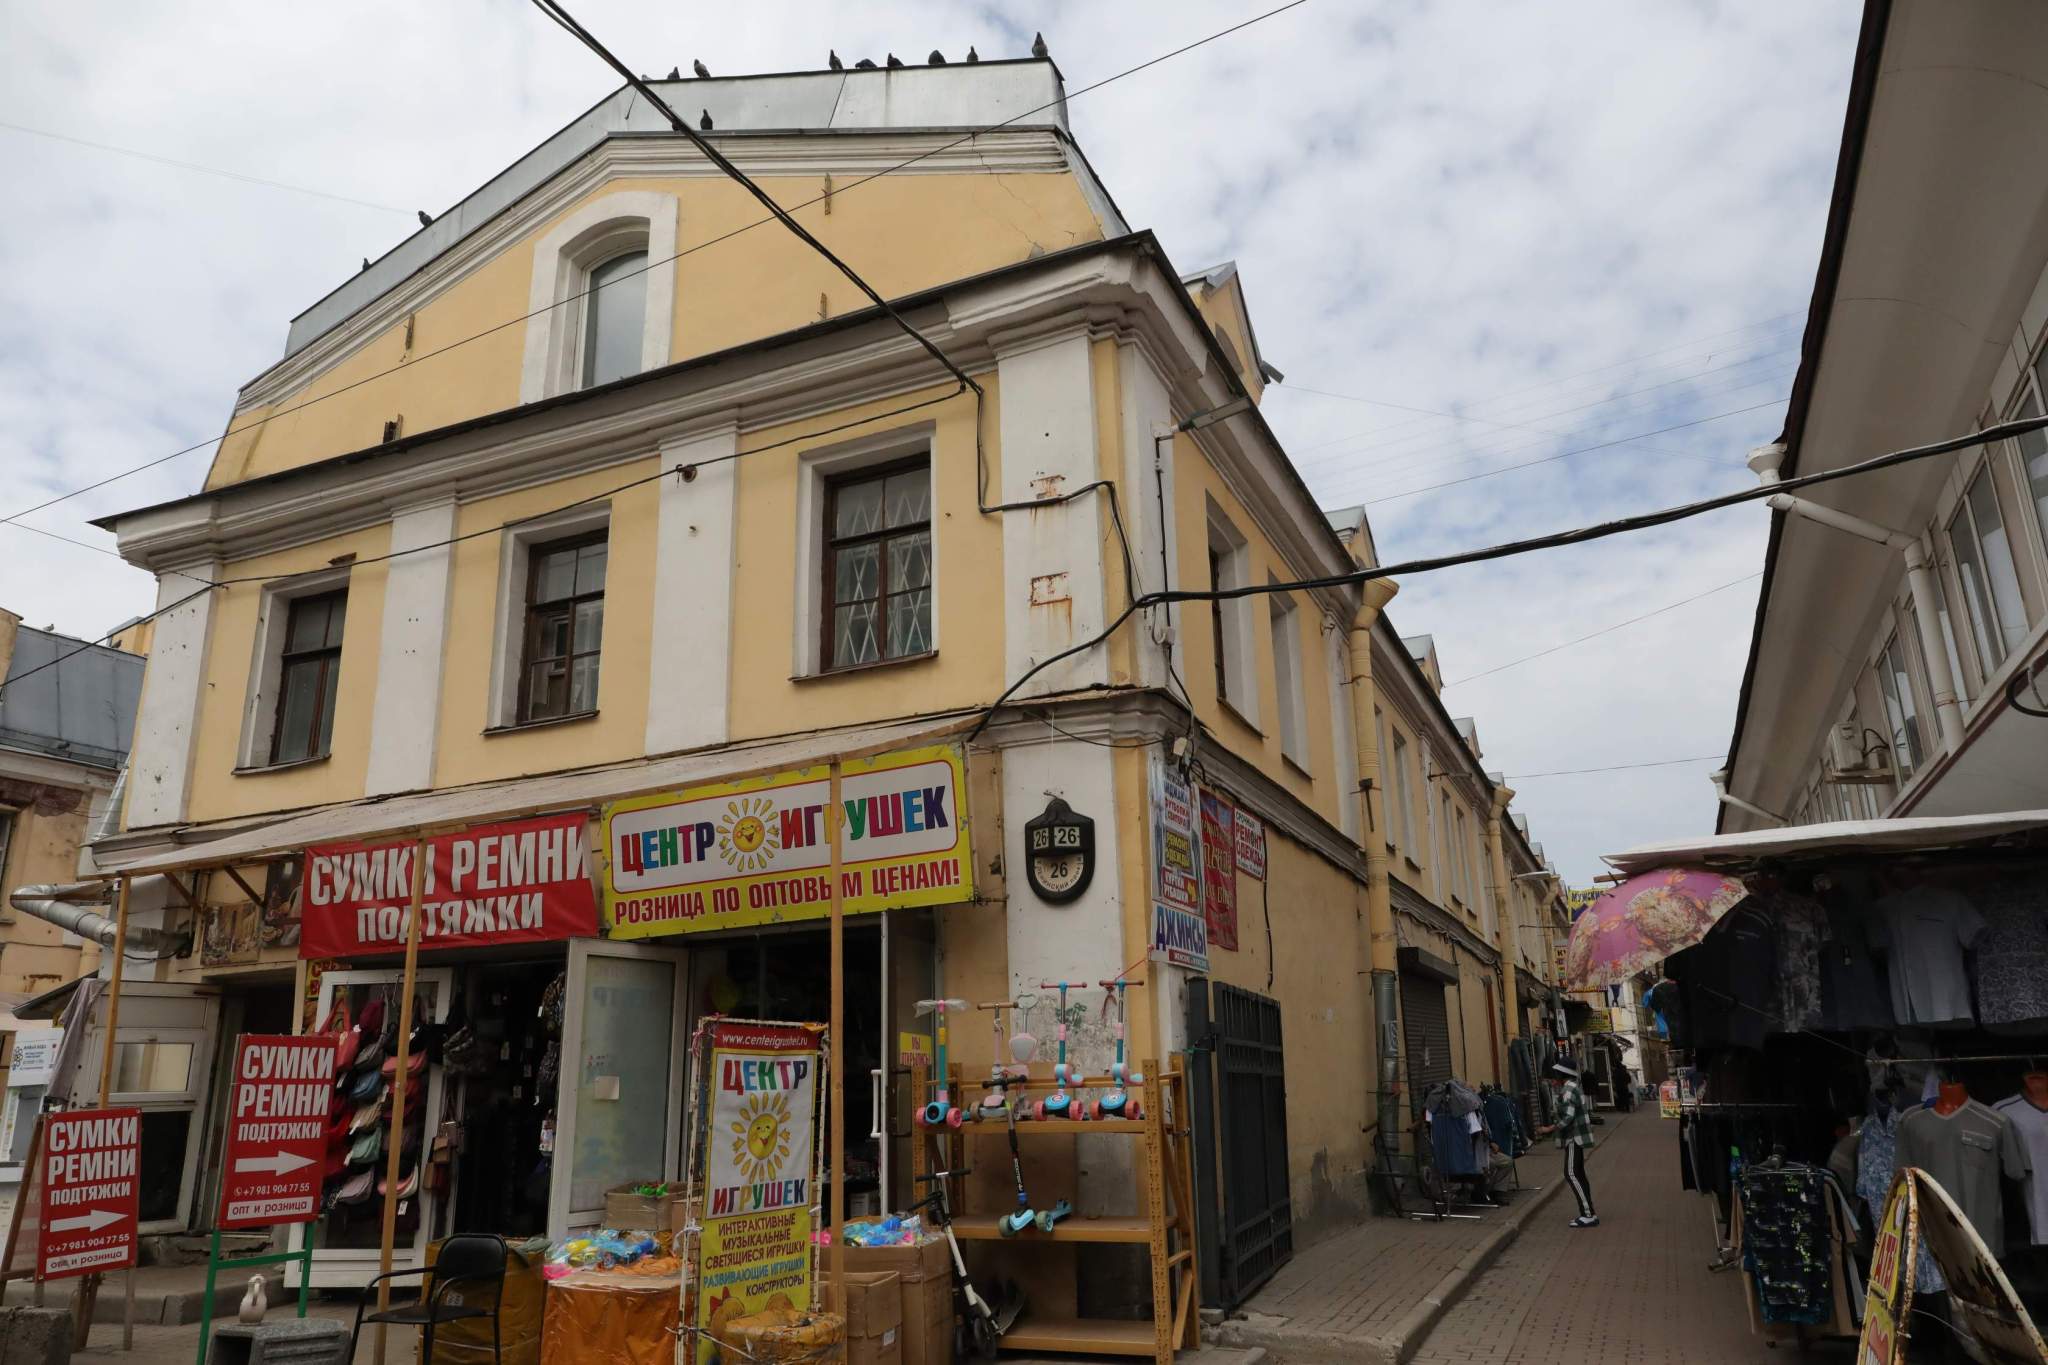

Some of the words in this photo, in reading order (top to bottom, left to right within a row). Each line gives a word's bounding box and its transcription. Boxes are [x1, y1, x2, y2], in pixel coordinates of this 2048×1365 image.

[621, 821, 715, 876] ЦЕНТР
[780, 785, 949, 850] ИГРУШЕК
[1035, 830, 1047, 847] 26
[1058, 828, 1076, 844] 26
[1236, 822, 1263, 847] РЕМОНТ
[311, 844, 436, 906] СУМКИ
[451, 826, 593, 893] РЕМНИ
[1050, 862, 1068, 879] 26
[615, 891, 705, 925] РОЗНИЦА
[712, 886, 740, 913] ПО
[748, 871, 863, 909] ОПТОВЫМ
[872, 858, 960, 897] ЦЕНАМ!
[357, 892, 544, 944] ПОДТЯЖКИ
[1156, 904, 1207, 957] ДЖИНСЫ
[242, 1045, 335, 1079] СУМКИ
[723, 1059, 808, 1096] ЦЕНТР
[237, 1084, 330, 1118] РЕМНИ
[50, 1116, 138, 1152] СУМКИ
[238, 1121, 322, 1143] ПОДТЯЖКИ
[48, 1148, 137, 1186] РЕМНИ
[50, 1181, 131, 1206] ПОДТЯЖКИ
[243, 1186, 255, 1196] +7
[256, 1185, 271, 1195] 981
[272, 1184, 288, 1193] 904
[289, 1183, 299, 1192] 77
[299, 1182, 311, 1192] 55
[712, 1178, 805, 1215] ИГРУШЕК
[232, 1205, 250, 1216] опт
[254, 1205, 261, 1213] и
[264, 1200, 307, 1216] розница
[718, 1212, 796, 1237] ИНТЕРАКТИВНЫЕ
[55, 1243, 67, 1252] +7
[69, 1240, 86, 1249] 981
[87, 1238, 105, 1247] 904
[106, 1235, 117, 1244] 77
[118, 1233, 130, 1242] 55
[722, 1228, 791, 1251] МУЗЫКАЛЬНЫЕ
[80, 1251, 122, 1264] розница
[705, 1247, 764, 1270] СВЕТЯЩИЕСЯ
[766, 1240, 805, 1260] ИГРУШКИ
[703, 1264, 769, 1288] РАЗВИВАЮЩИЕ
[770, 1257, 805, 1276] ИГРУШКИ
[746, 1273, 805, 1297] КОНСТРУКТОРЫ
